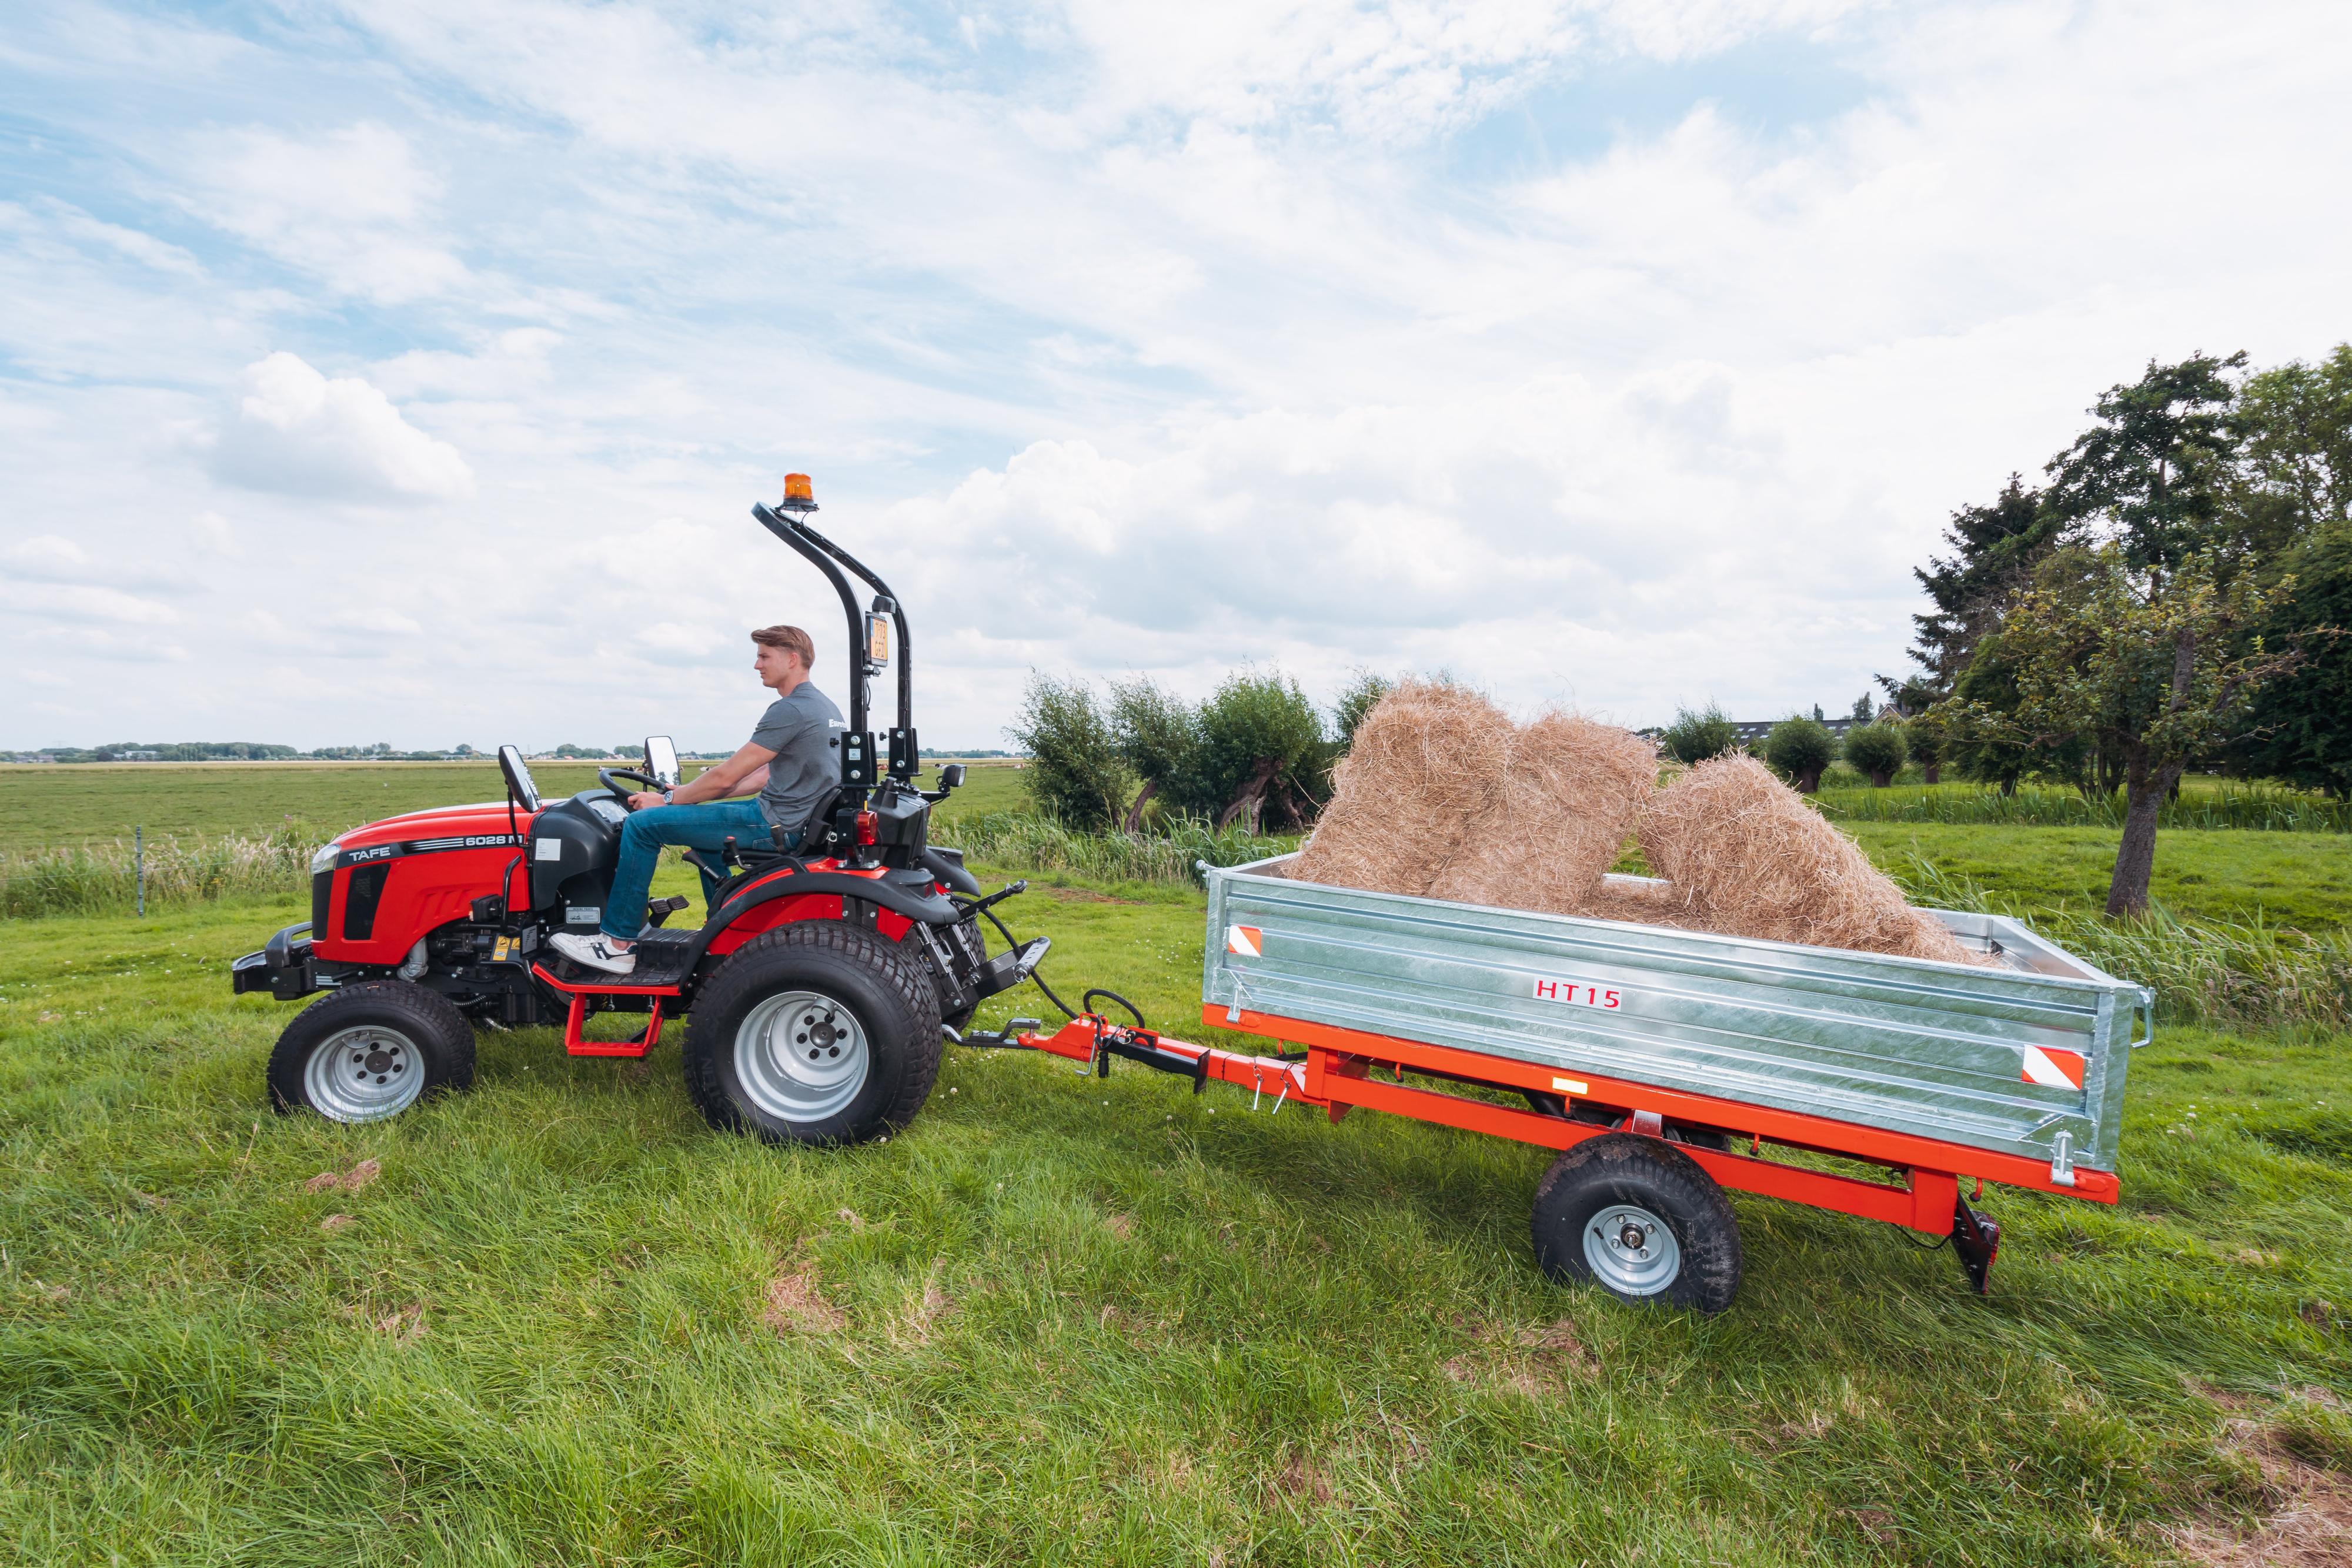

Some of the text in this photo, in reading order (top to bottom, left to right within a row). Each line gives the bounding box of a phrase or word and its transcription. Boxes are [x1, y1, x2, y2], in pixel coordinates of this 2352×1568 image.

[349, 847, 390, 861] TAFE
[466, 836, 506, 846] 6028
[1537, 980, 1619, 1008] HT15
